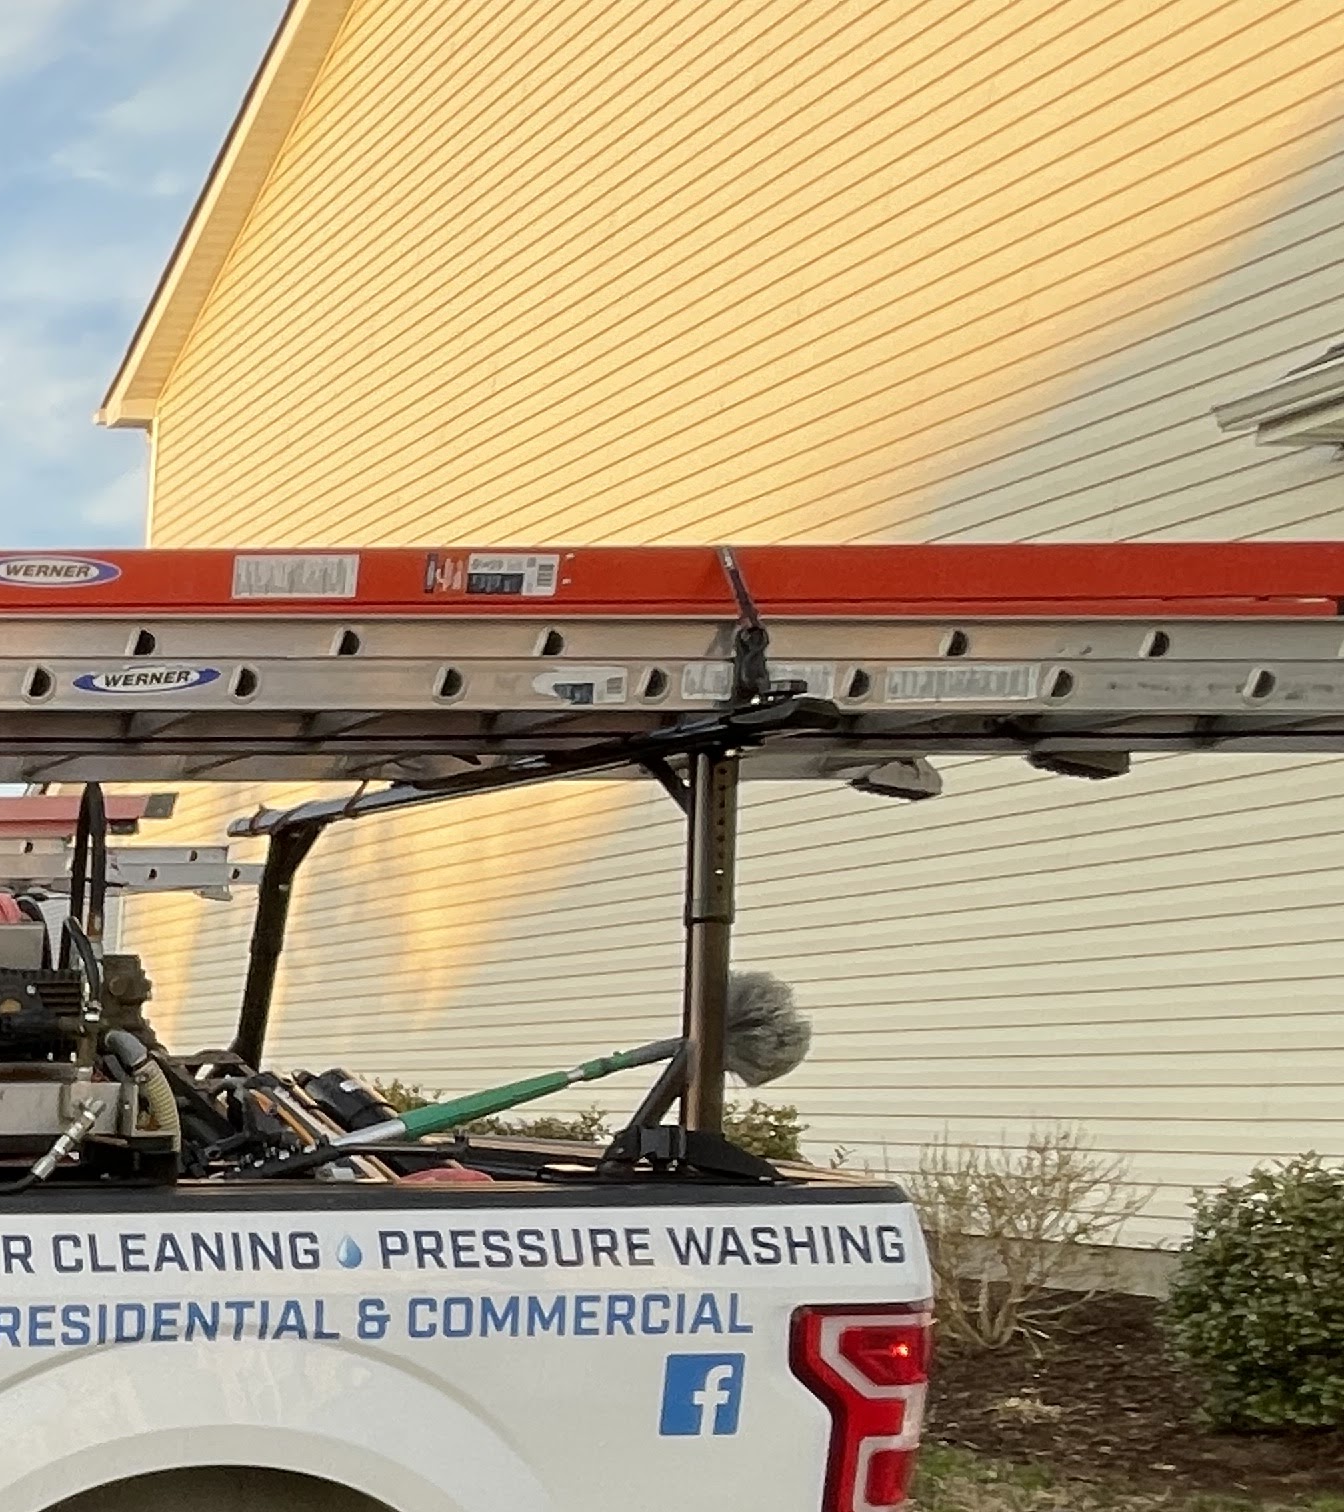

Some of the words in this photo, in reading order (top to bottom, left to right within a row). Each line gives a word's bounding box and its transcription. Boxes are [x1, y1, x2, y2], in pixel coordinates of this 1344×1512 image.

[5, 564, 91, 578] WERNER
[103, 670, 191, 688] WERNER
[52, 1230, 321, 1274] CLEANING
[378, 1227, 656, 1269] PRESSURE
[665, 1225, 906, 1266] WASHING
[356, 1298, 391, 1340] &
[407, 1293, 755, 1339] COMMERCIAL
